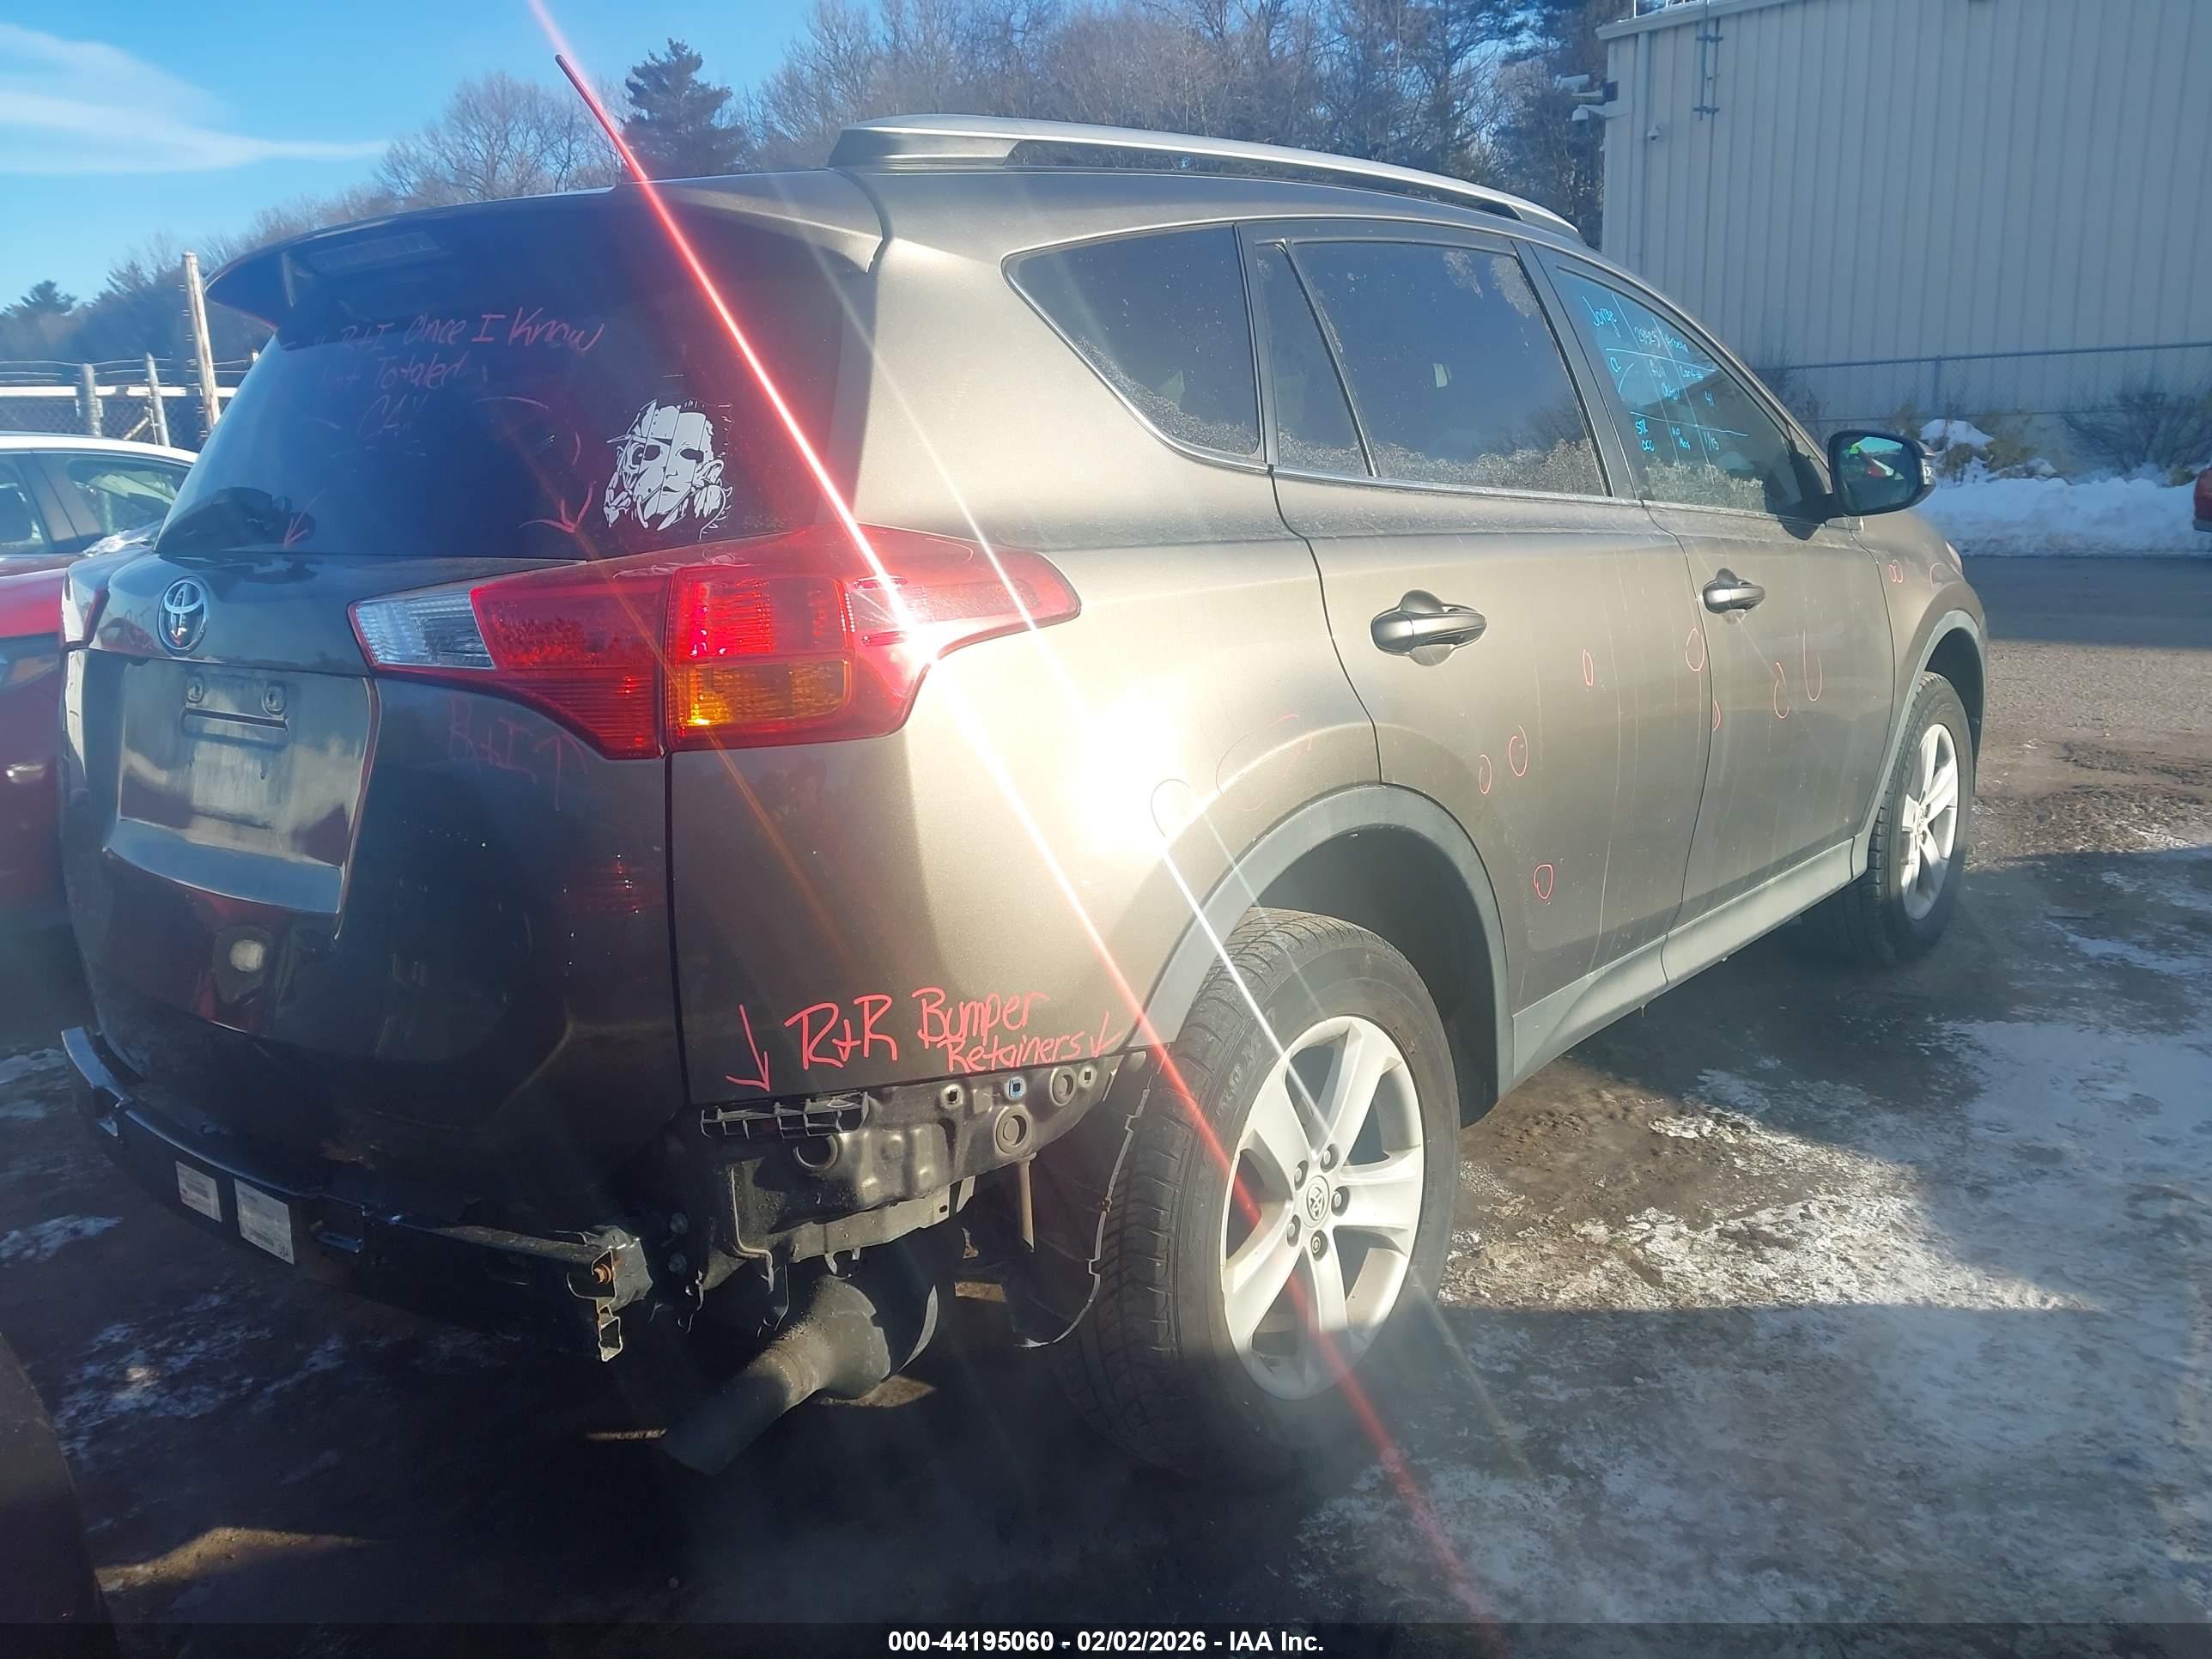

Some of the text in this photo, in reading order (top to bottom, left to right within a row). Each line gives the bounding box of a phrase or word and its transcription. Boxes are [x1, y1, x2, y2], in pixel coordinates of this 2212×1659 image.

[404, 312, 467, 345] Once
[471, 313, 506, 343] I
[508, 307, 605, 353] Know
[784, 987, 1048, 1071] R+R Bumper
[937, 1030, 1086, 1073] Retainers
